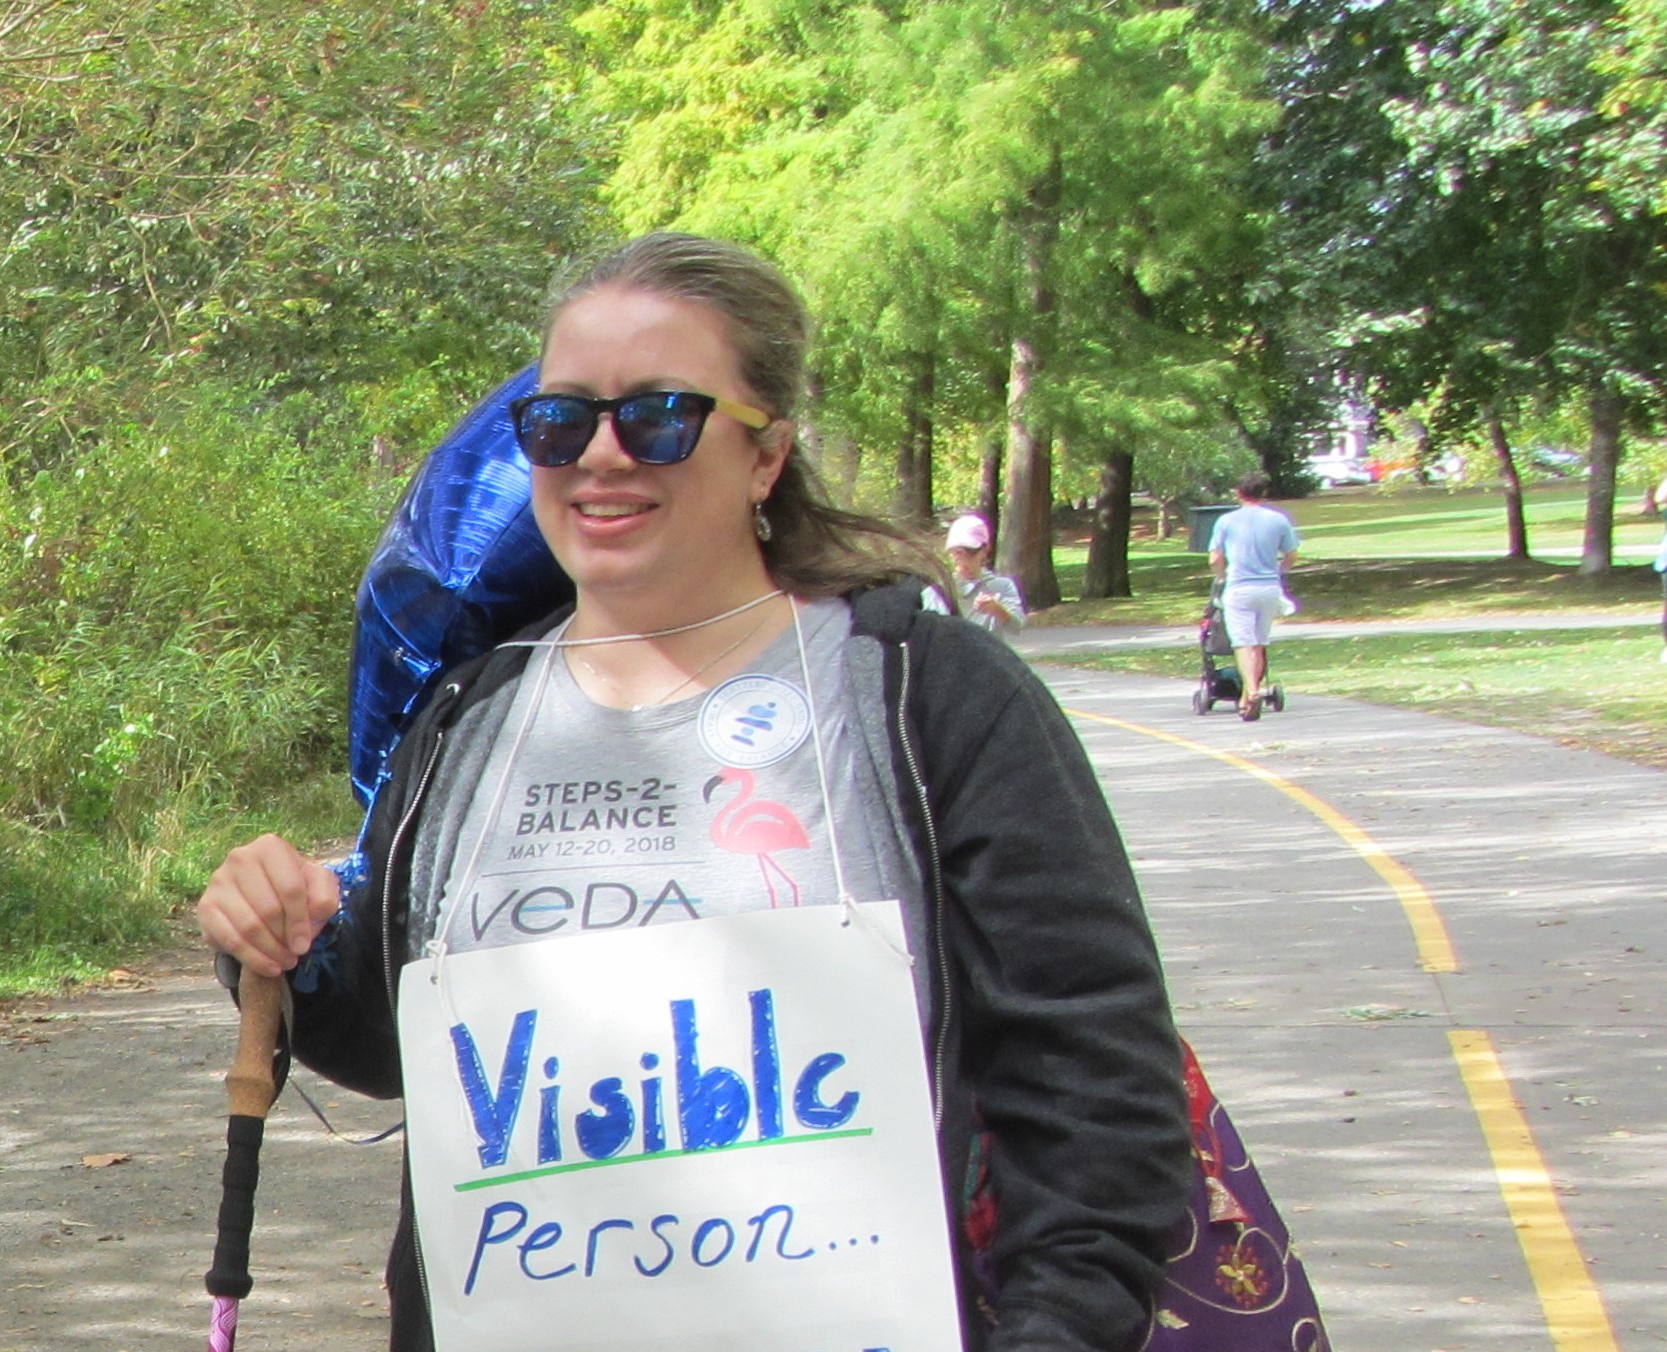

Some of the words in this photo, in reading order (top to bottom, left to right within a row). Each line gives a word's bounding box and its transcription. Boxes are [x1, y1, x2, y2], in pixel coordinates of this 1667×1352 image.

[524, 777, 678, 807] STEPS-2-
[515, 804, 678, 837] BALANCE
[507, 842, 552, 861] MAY
[555, 838, 617, 857] 12-20,
[623, 835, 677, 853] 2018
